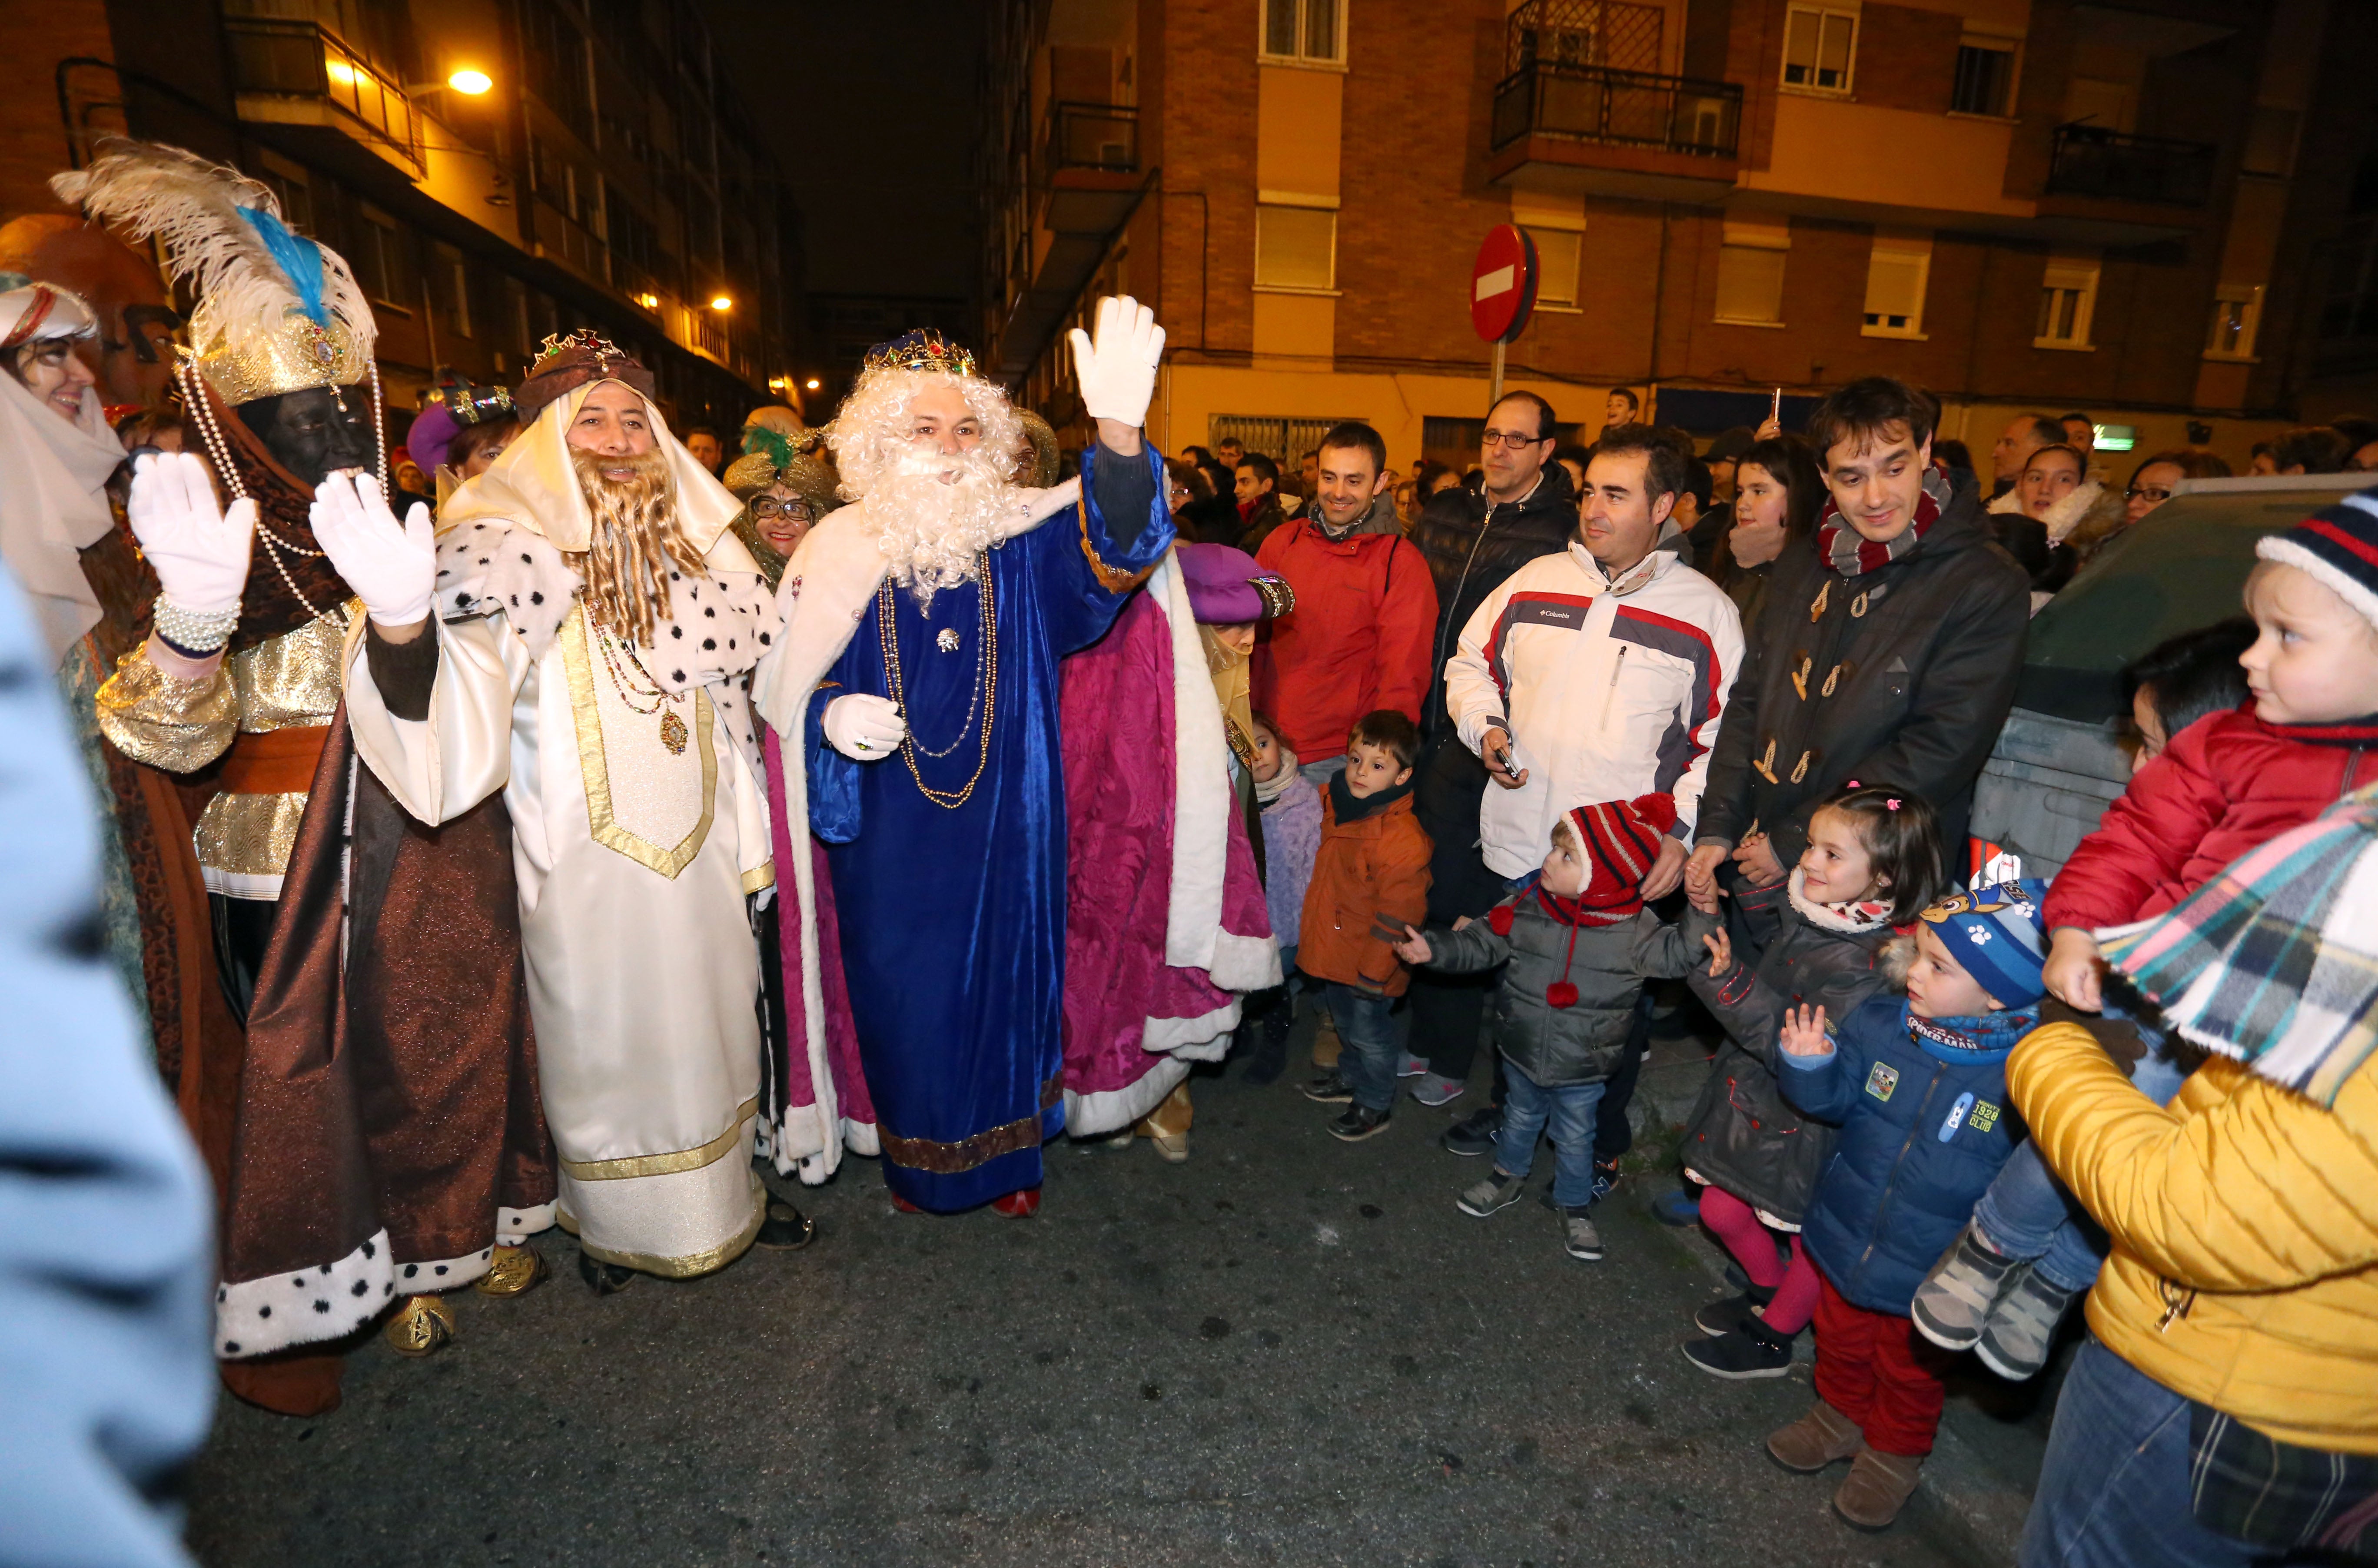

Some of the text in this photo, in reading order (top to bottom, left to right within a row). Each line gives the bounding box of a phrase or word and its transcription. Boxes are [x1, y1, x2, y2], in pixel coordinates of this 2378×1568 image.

[1546, 610, 1570, 619] Columbia
[1973, 1104, 1998, 1122] 1928
[1969, 1117, 1991, 1133] CLUB
